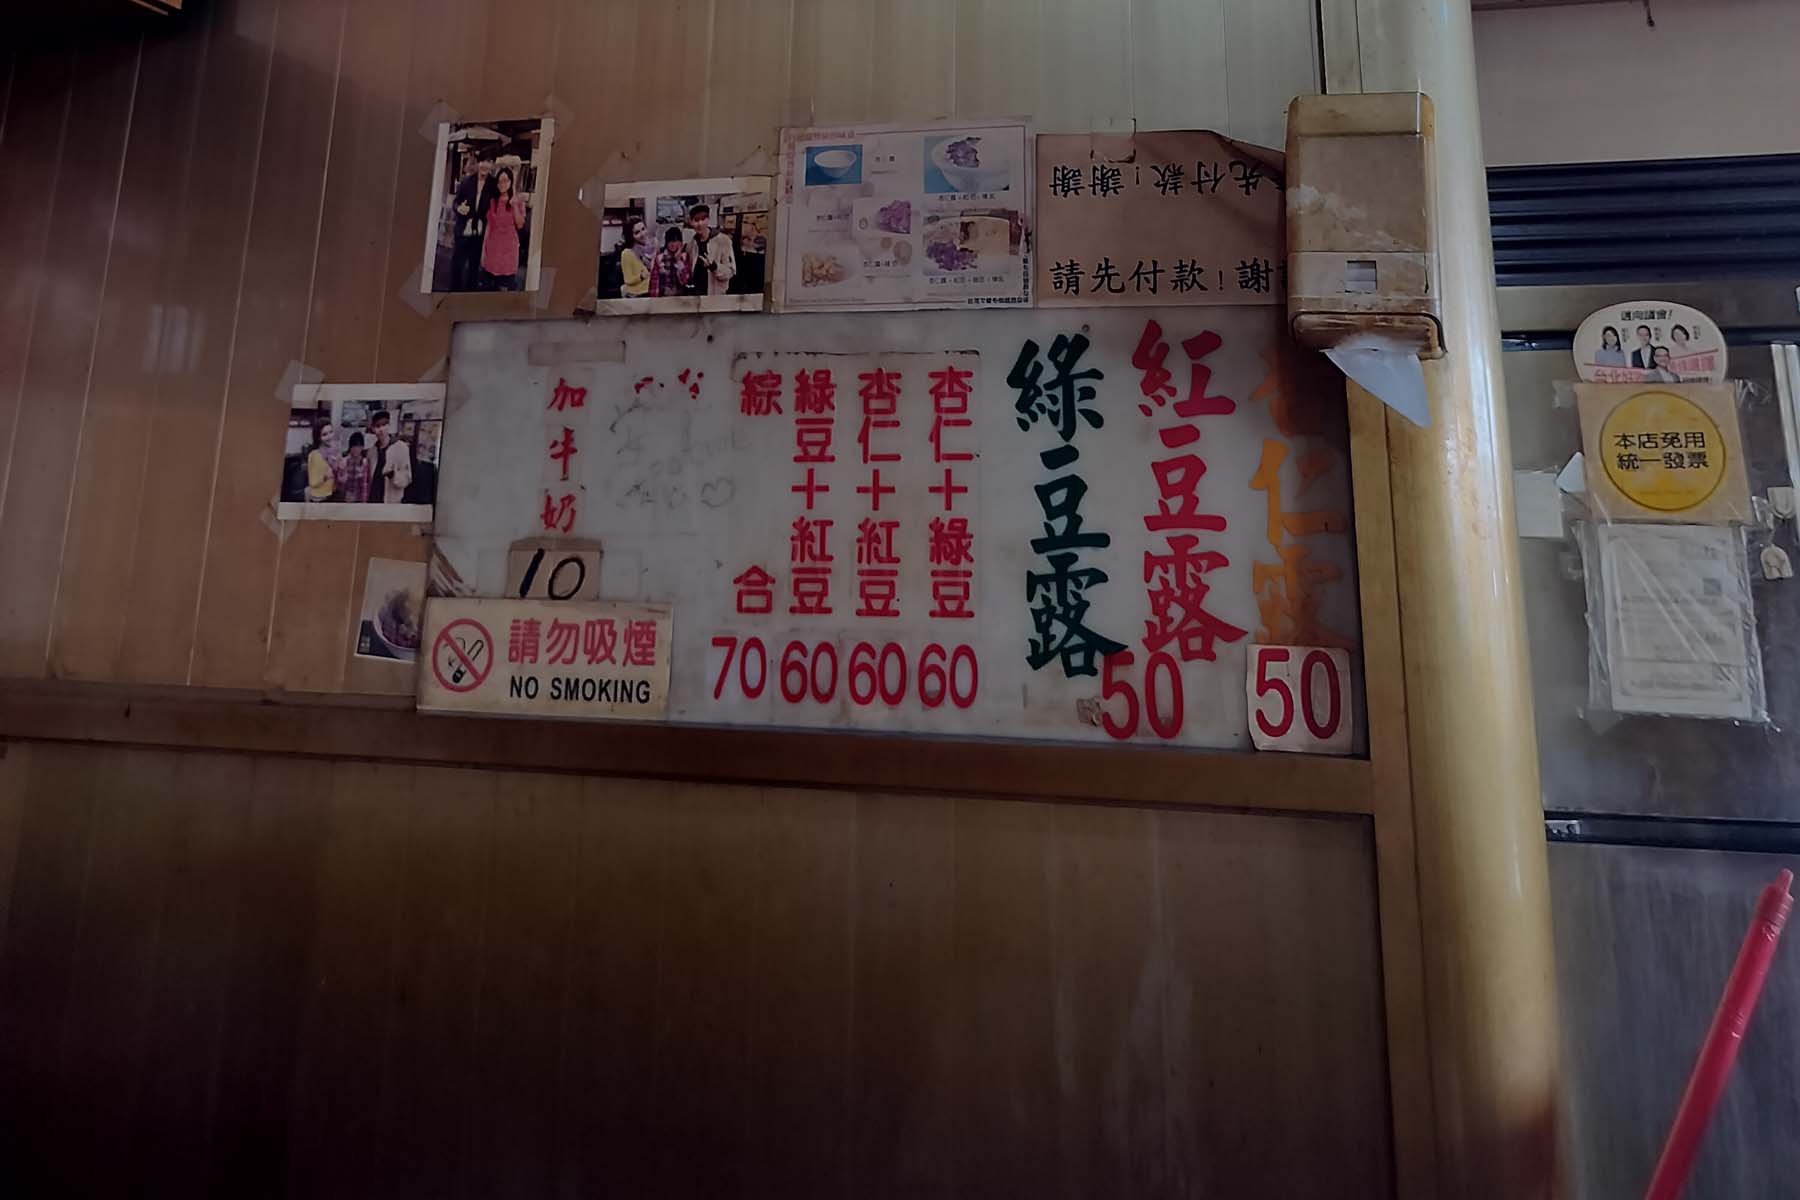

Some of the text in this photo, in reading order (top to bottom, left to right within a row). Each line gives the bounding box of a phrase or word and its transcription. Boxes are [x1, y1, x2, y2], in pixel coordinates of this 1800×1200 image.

[1049, 256, 1286, 295] 請先付款！謝
[542, 377, 588, 535] 加牛奶
[1613, 431, 1706, 450] 本店免用
[1616, 451, 1710, 471] 統一發票
[790, 368, 837, 615] 綠豆+紅豆
[856, 368, 903, 618] 杏仁+紅豆
[928, 366, 976, 619] 杏仁+綠豆
[1006, 333, 1129, 678] 綠豆露
[1132, 319, 1248, 662] 紅豆露
[519, 548, 587, 600] 10
[507, 618, 657, 668] 請勿吸煙
[711, 636, 767, 701] 70
[779, 640, 839, 705] 60
[847, 641, 908, 707] 60
[509, 676, 652, 705] NO SMOKING
[917, 643, 979, 710] 60
[1101, 650, 1184, 740] 50
[1255, 648, 1341, 739] 50
